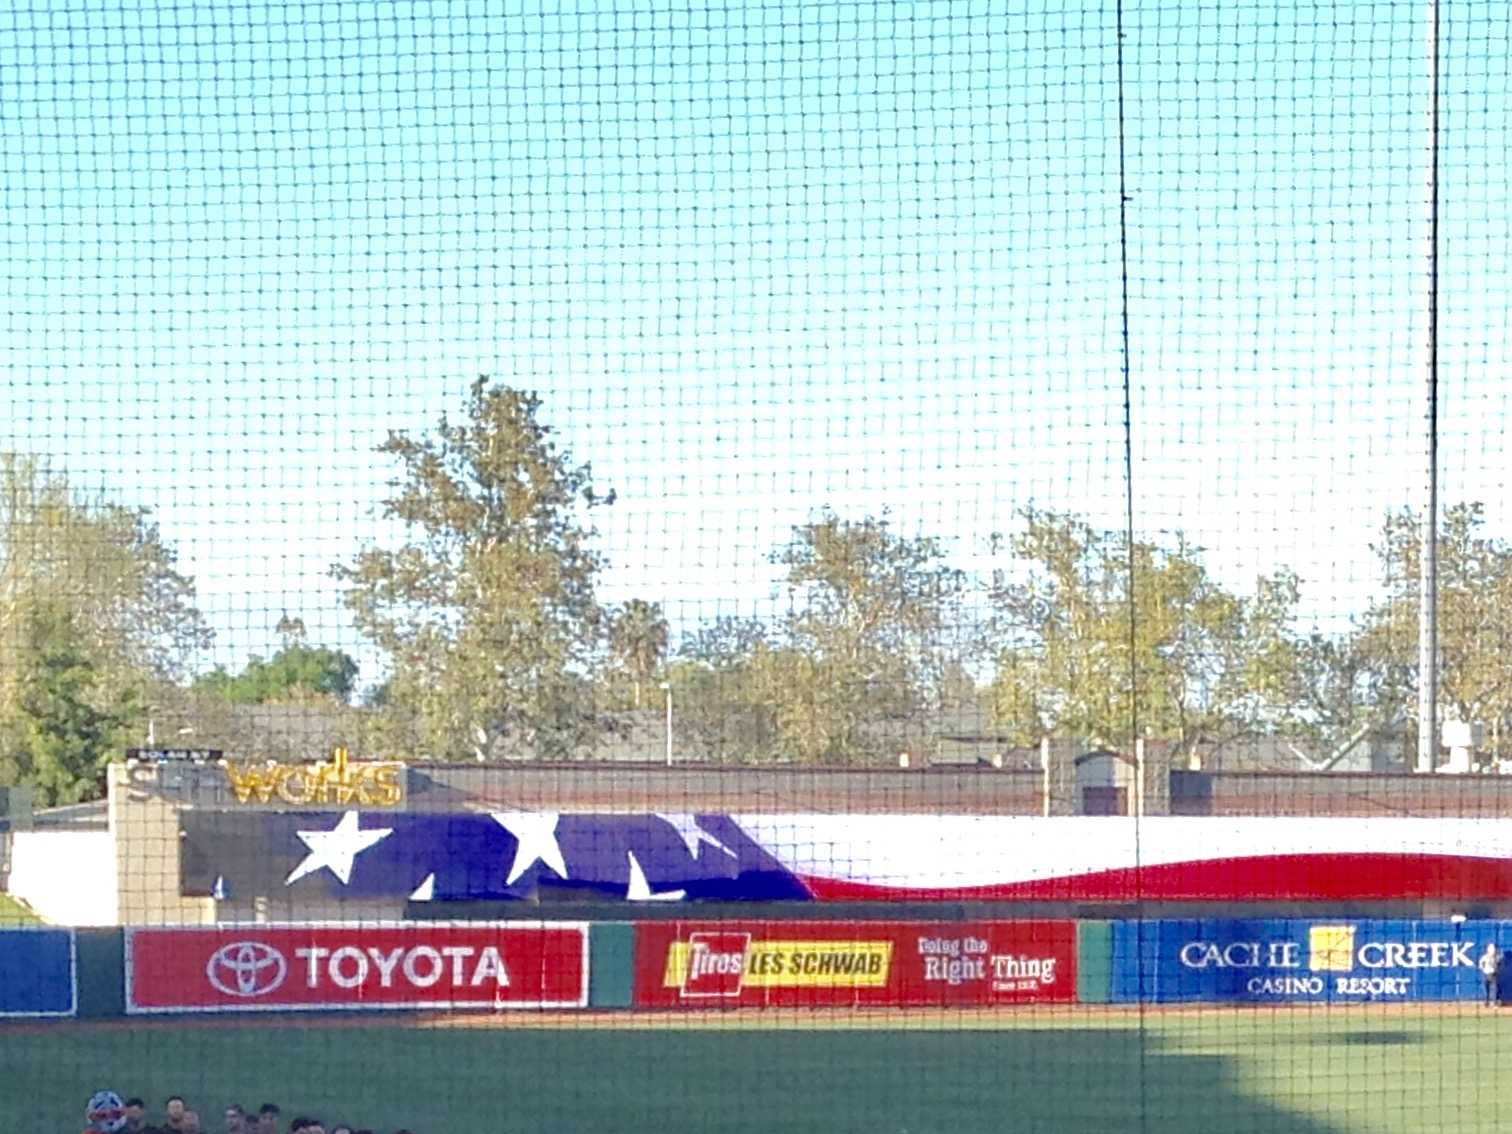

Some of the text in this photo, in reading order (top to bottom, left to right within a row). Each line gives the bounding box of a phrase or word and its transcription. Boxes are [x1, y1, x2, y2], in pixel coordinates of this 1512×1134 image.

[295, 946, 509, 989] TOYOTA
[749, 952, 785, 976] LES
[788, 951, 883, 976] SCHWAB
[1180, 942, 1475, 968] CACHE CREEK
[924, 954, 1057, 985] Right Thing
[1248, 977, 1323, 995] CASINO
